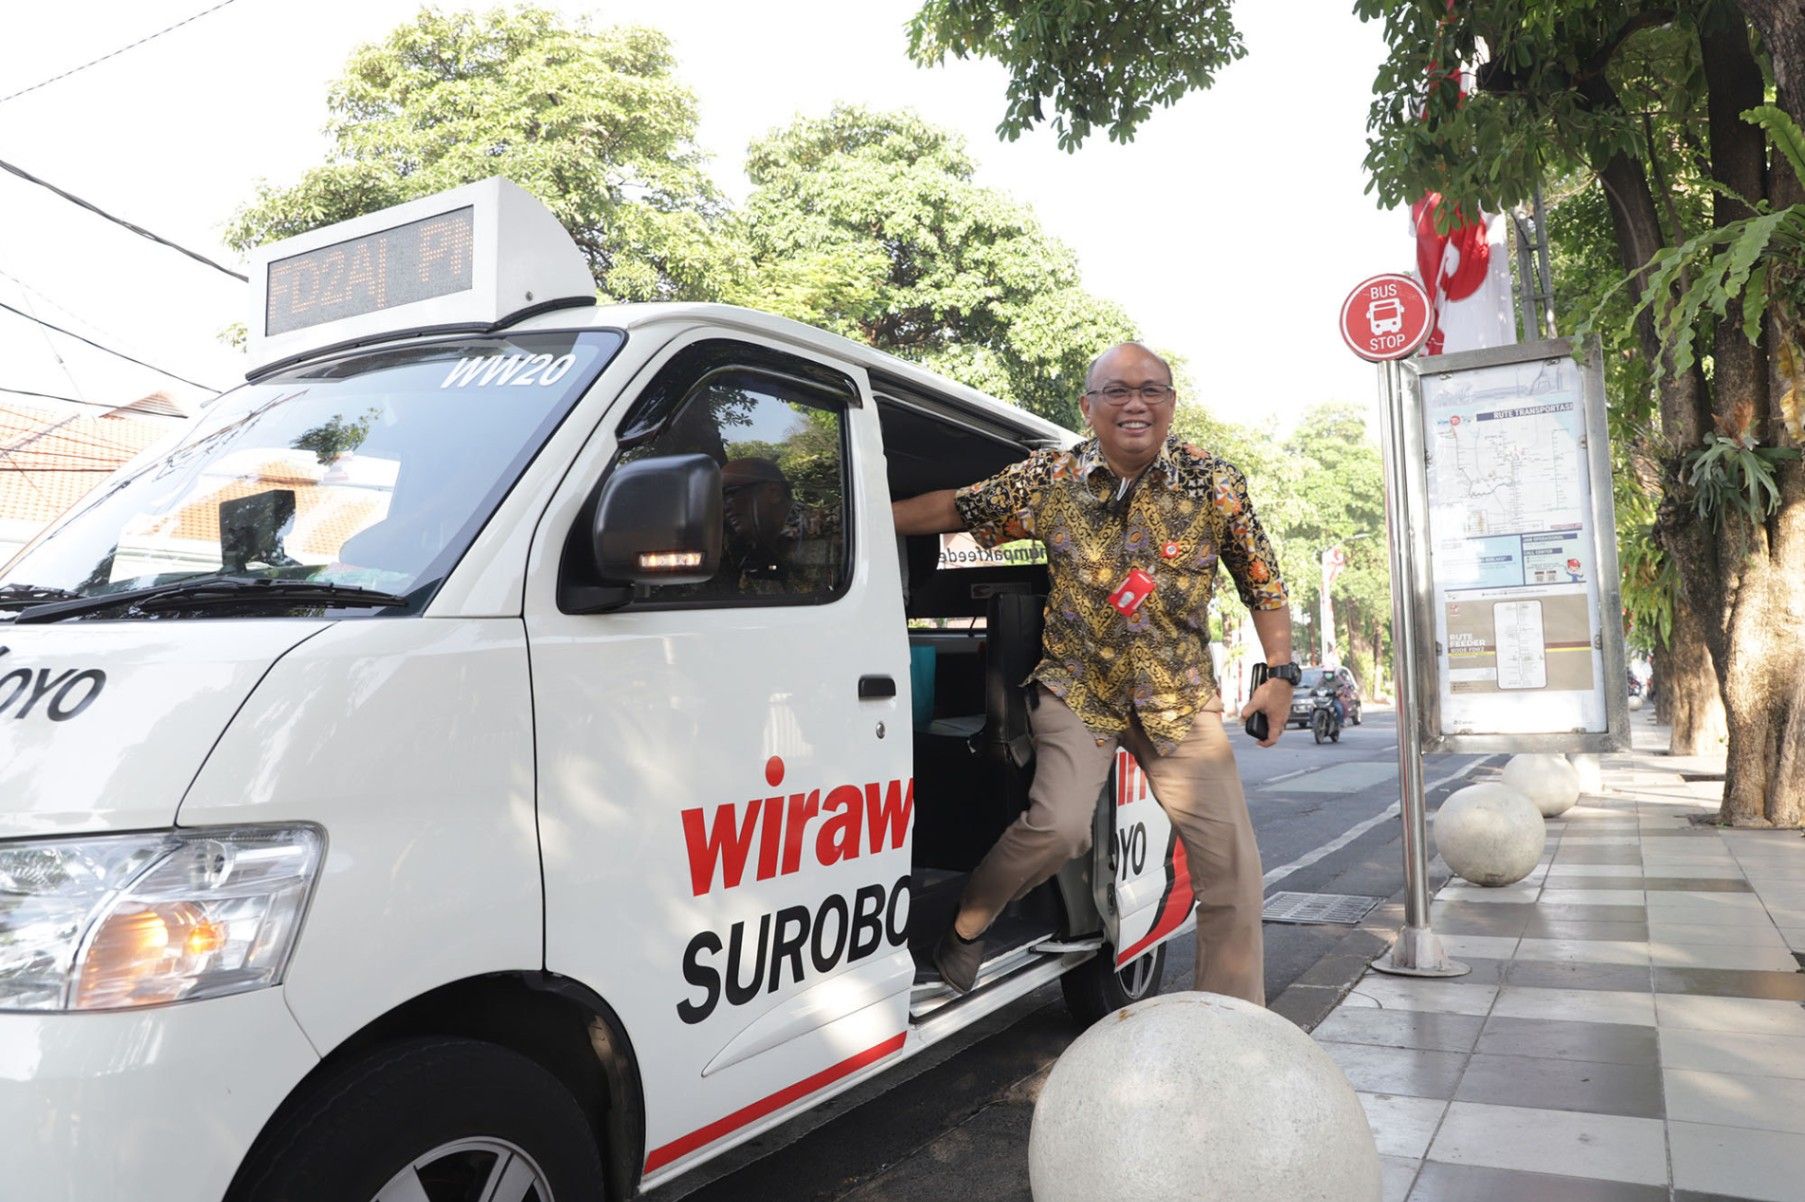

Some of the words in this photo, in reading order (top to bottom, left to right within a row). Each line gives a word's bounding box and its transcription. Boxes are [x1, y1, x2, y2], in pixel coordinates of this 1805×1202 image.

[1370, 283, 1398, 300] BUS
[1369, 333, 1406, 351] STOP
[440, 354, 577, 389] WW20
[1493, 409, 1514, 419] RUTE
[676, 874, 912, 1025] SUROBO
